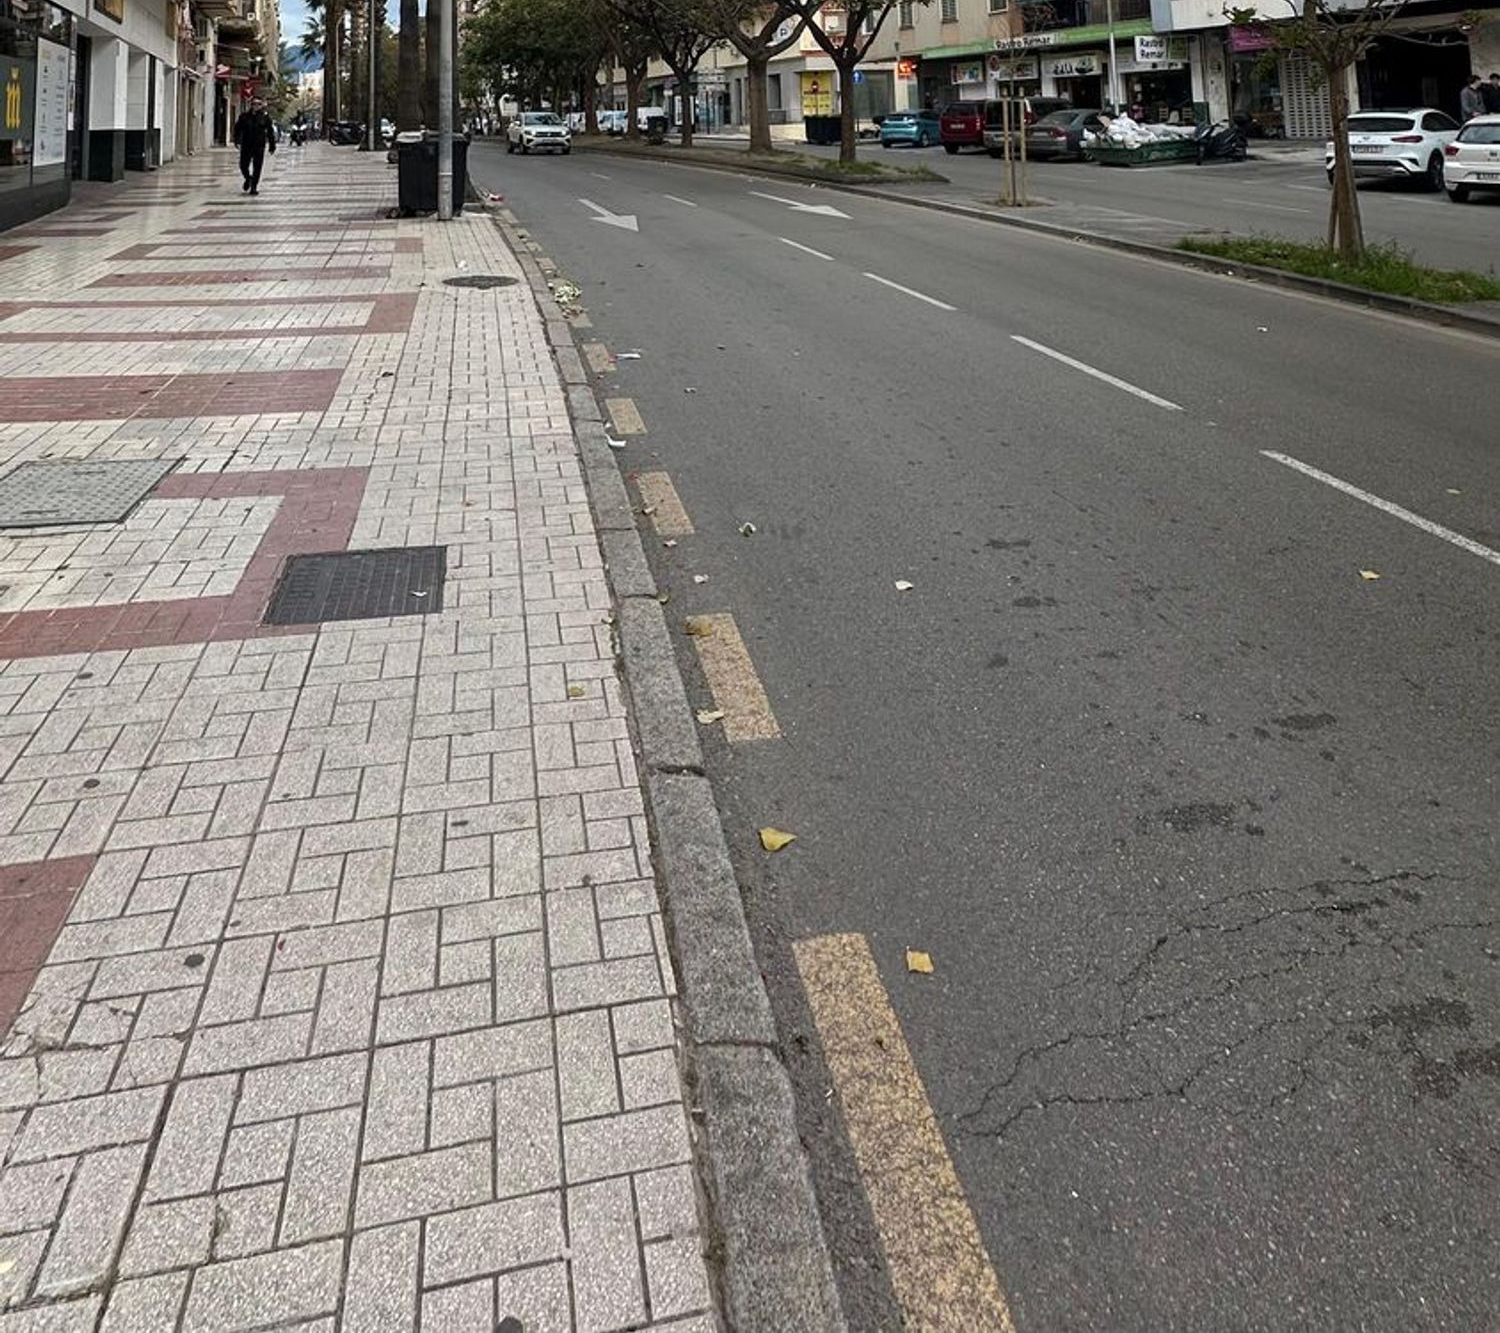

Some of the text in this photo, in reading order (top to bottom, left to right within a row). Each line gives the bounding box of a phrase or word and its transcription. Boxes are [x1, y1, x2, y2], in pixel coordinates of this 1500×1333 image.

[996, 36, 1051, 50] Rastro Remar
[1140, 38, 1164, 48] Rastro
[1140, 48, 1165, 59] Remar
